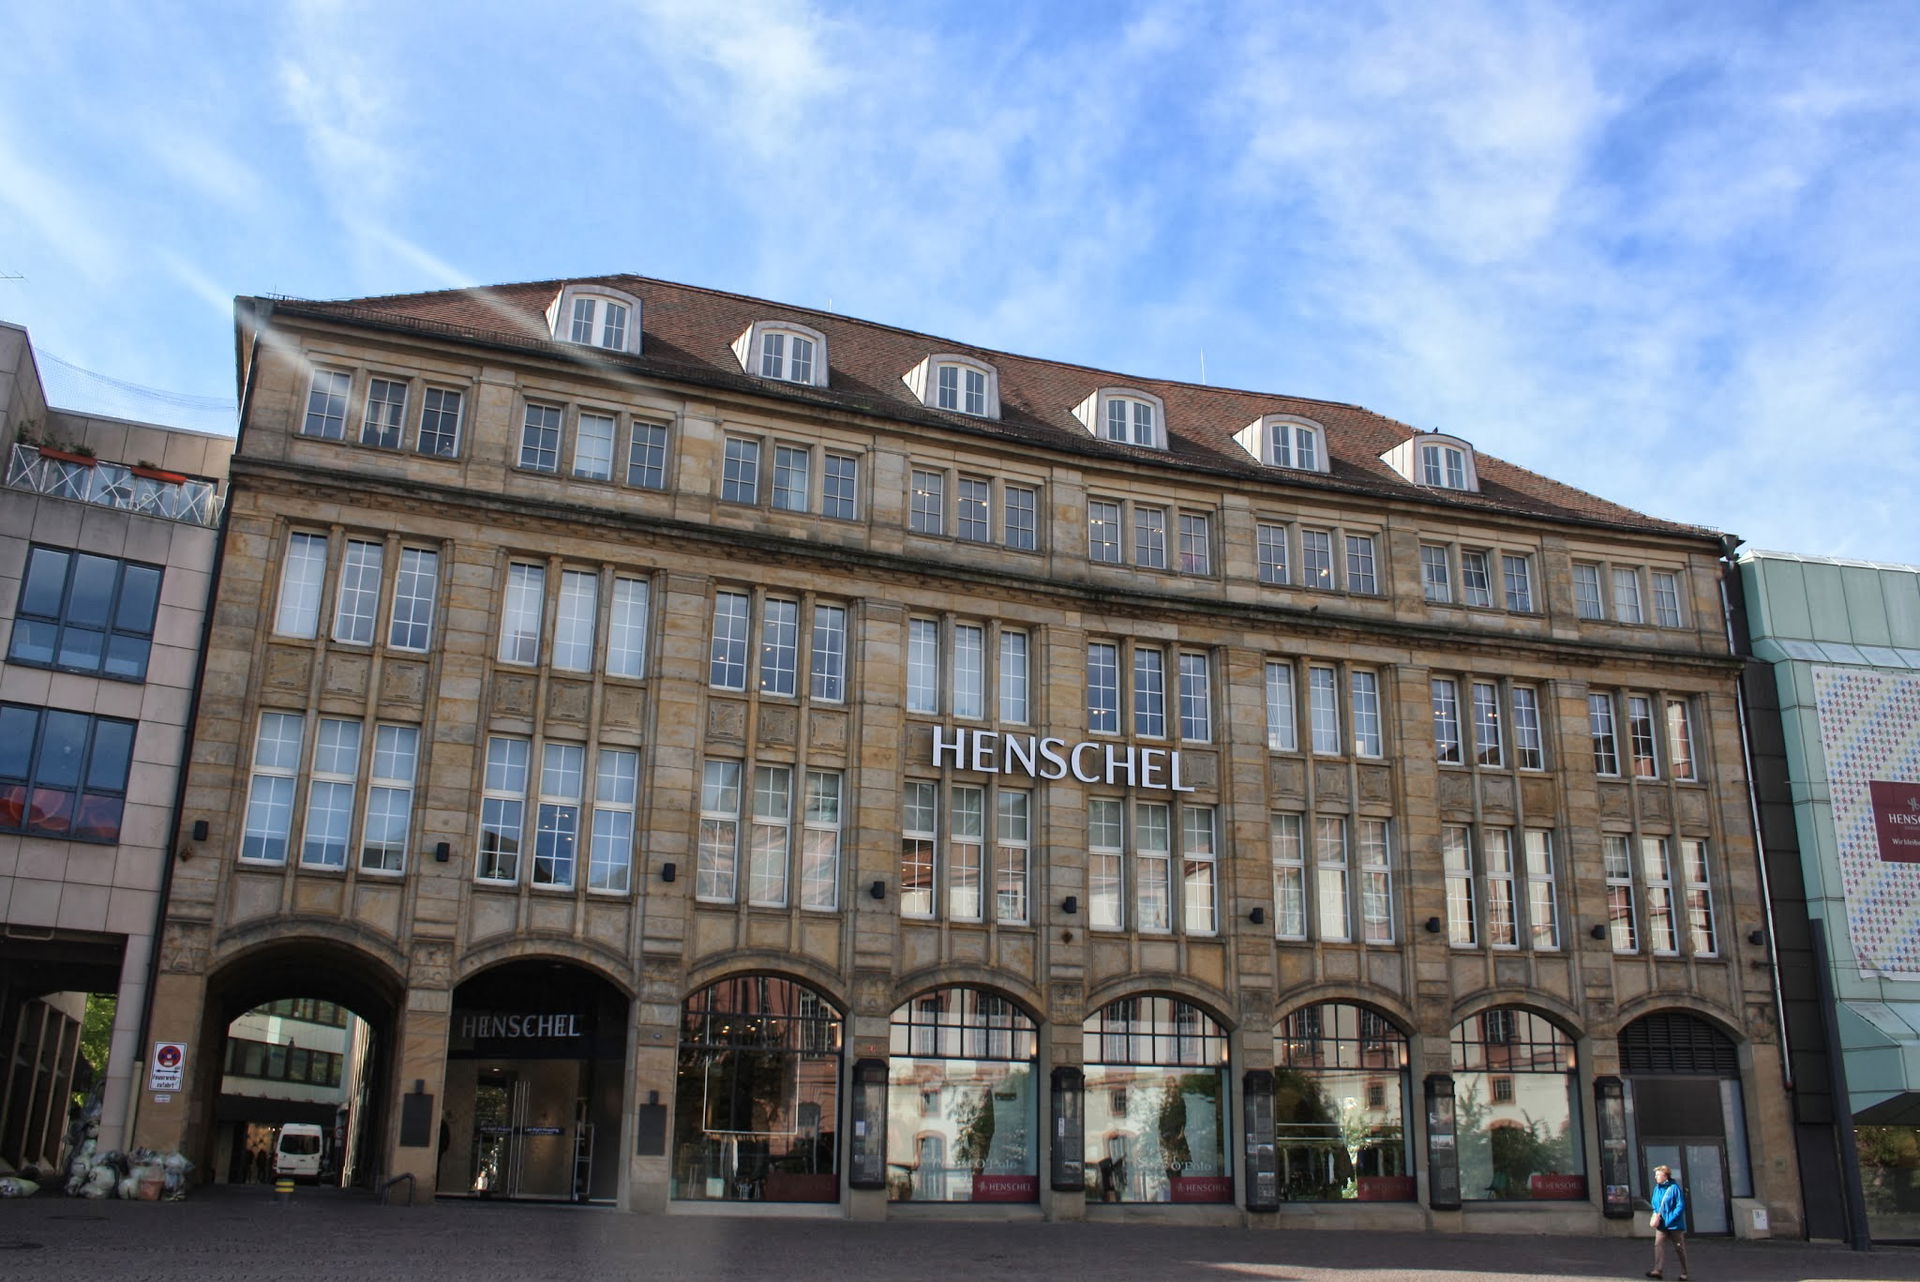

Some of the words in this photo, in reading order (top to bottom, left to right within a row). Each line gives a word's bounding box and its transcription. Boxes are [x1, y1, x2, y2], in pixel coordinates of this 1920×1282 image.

[932, 725, 1195, 792] HENSCHEL
[461, 1014, 581, 1038] HENSCHEL
[989, 1182, 1032, 1192] HENSCHEL
